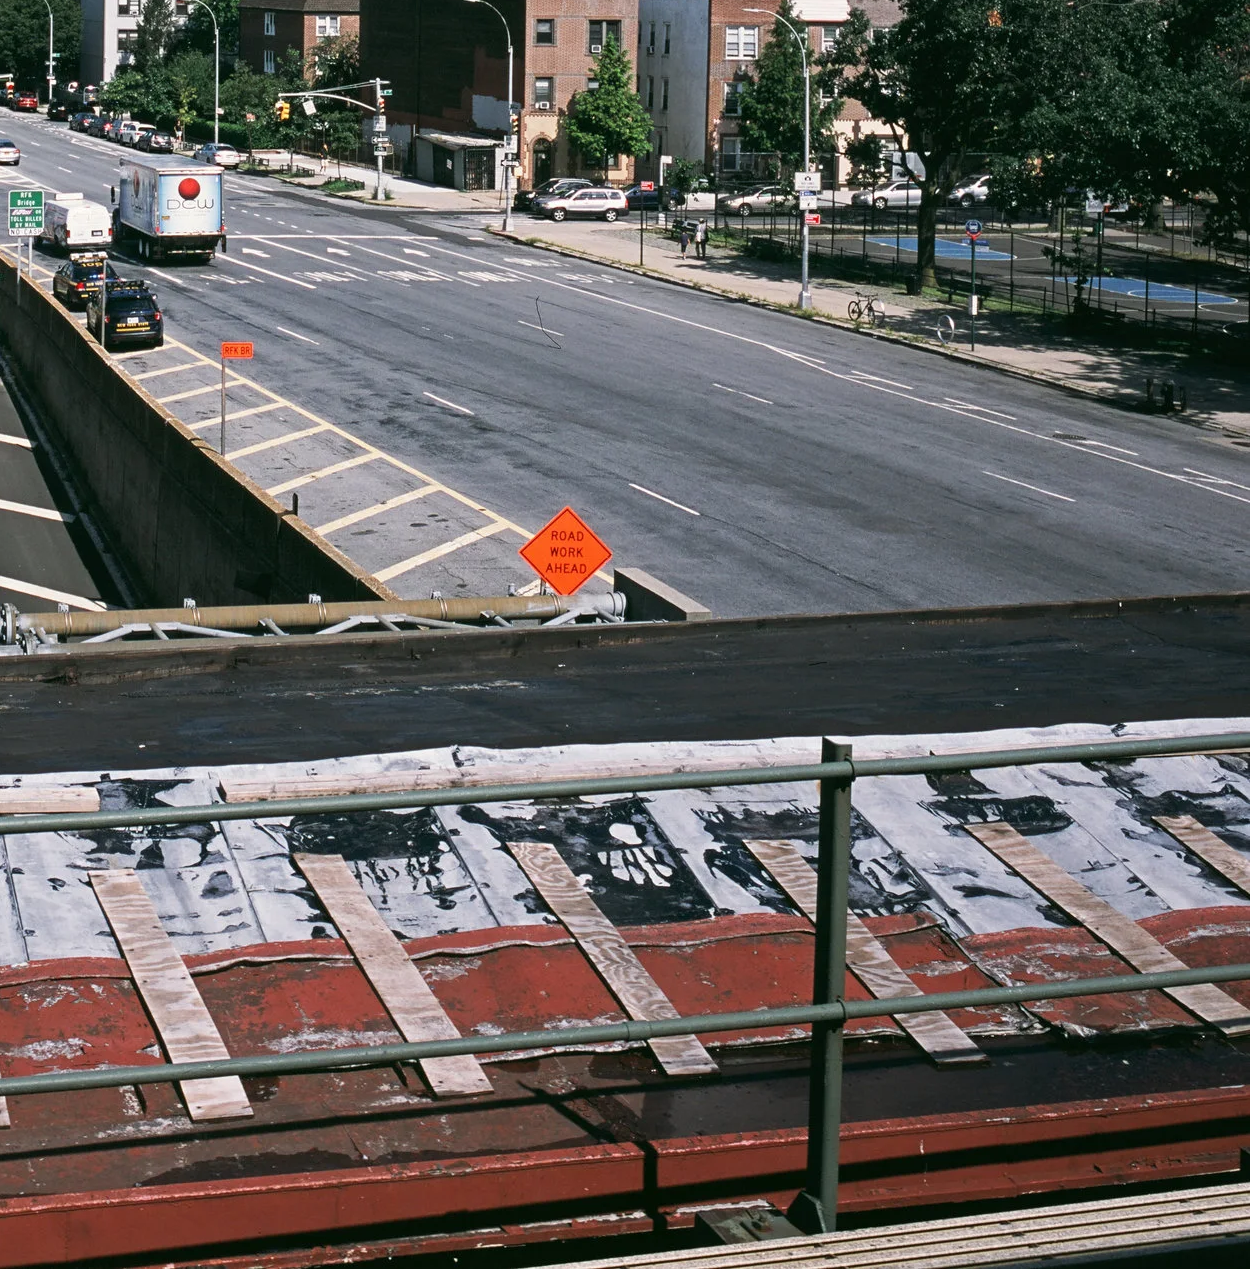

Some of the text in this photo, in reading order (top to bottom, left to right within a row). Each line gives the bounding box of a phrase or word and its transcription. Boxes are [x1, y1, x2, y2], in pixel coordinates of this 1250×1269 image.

[166, 198, 214, 209] DCW
[225, 346, 250, 355] RFK BR
[551, 530, 584, 541] ROAD
[550, 546, 584, 558] WORK
[545, 563, 587, 574] AHEAD
